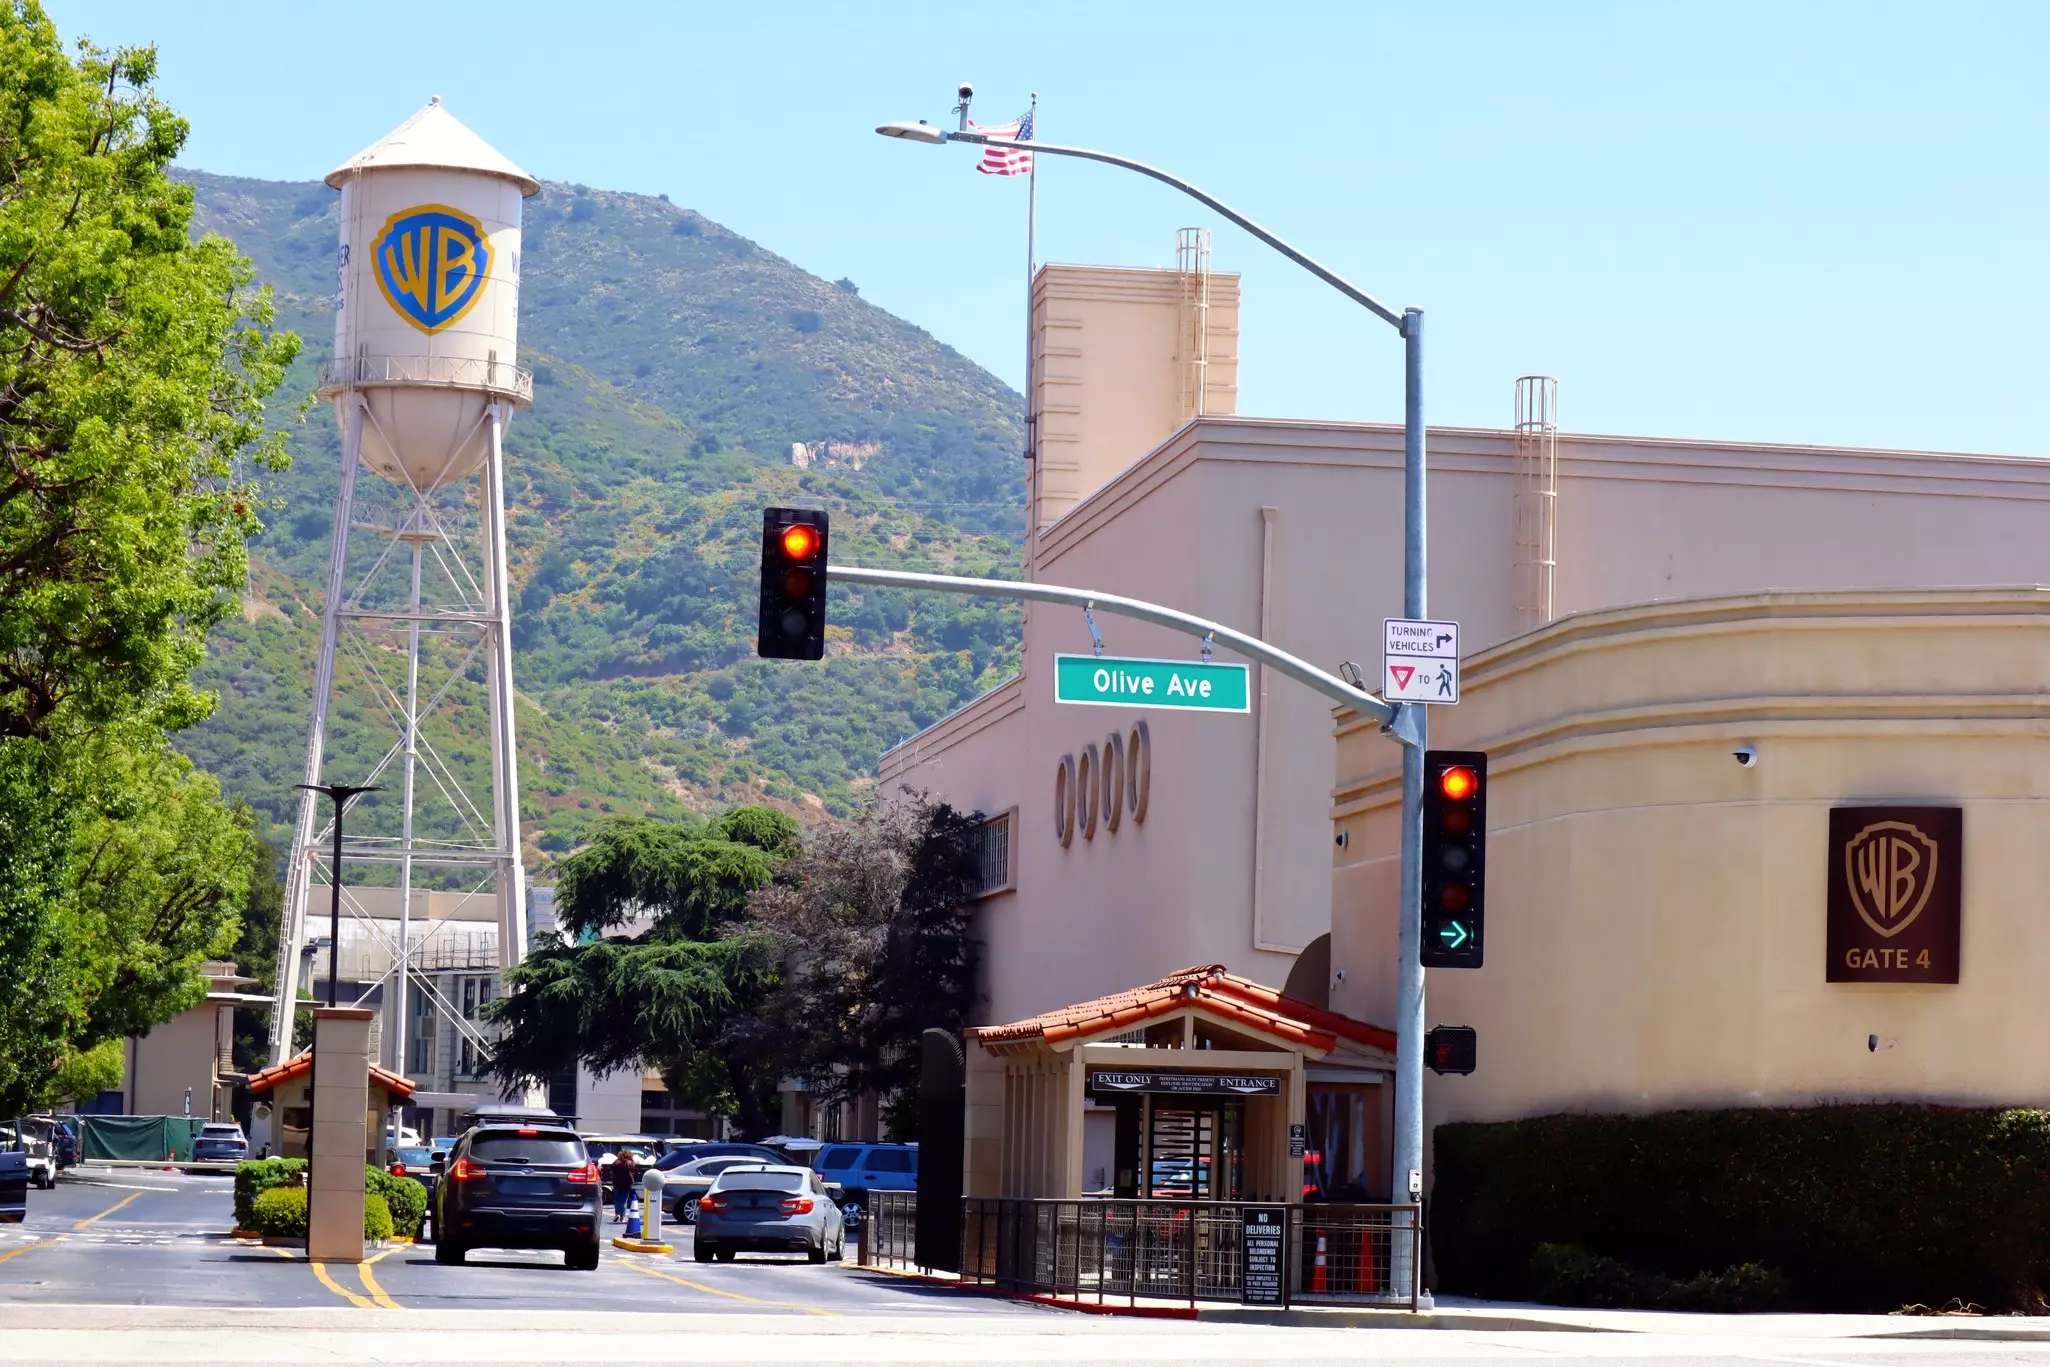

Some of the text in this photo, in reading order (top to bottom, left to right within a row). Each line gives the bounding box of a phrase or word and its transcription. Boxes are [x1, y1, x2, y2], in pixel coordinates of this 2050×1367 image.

[386, 226, 476, 313] WB
[1392, 626, 1432, 637] TURNING
[1390, 641, 1434, 652] VEHICLES
[1093, 668, 1212, 698] Olive Ave
[1418, 674, 1430, 684] TO
[1858, 836, 1920, 920] WB
[1846, 948, 1930, 969] GATE 4
[1098, 1074, 1152, 1084] EXIT ONLY
[1220, 1078, 1275, 1088] ENTRANCE
[1258, 1214, 1268, 1222] NO
[1246, 1225, 1280, 1235] DELIVERIES
